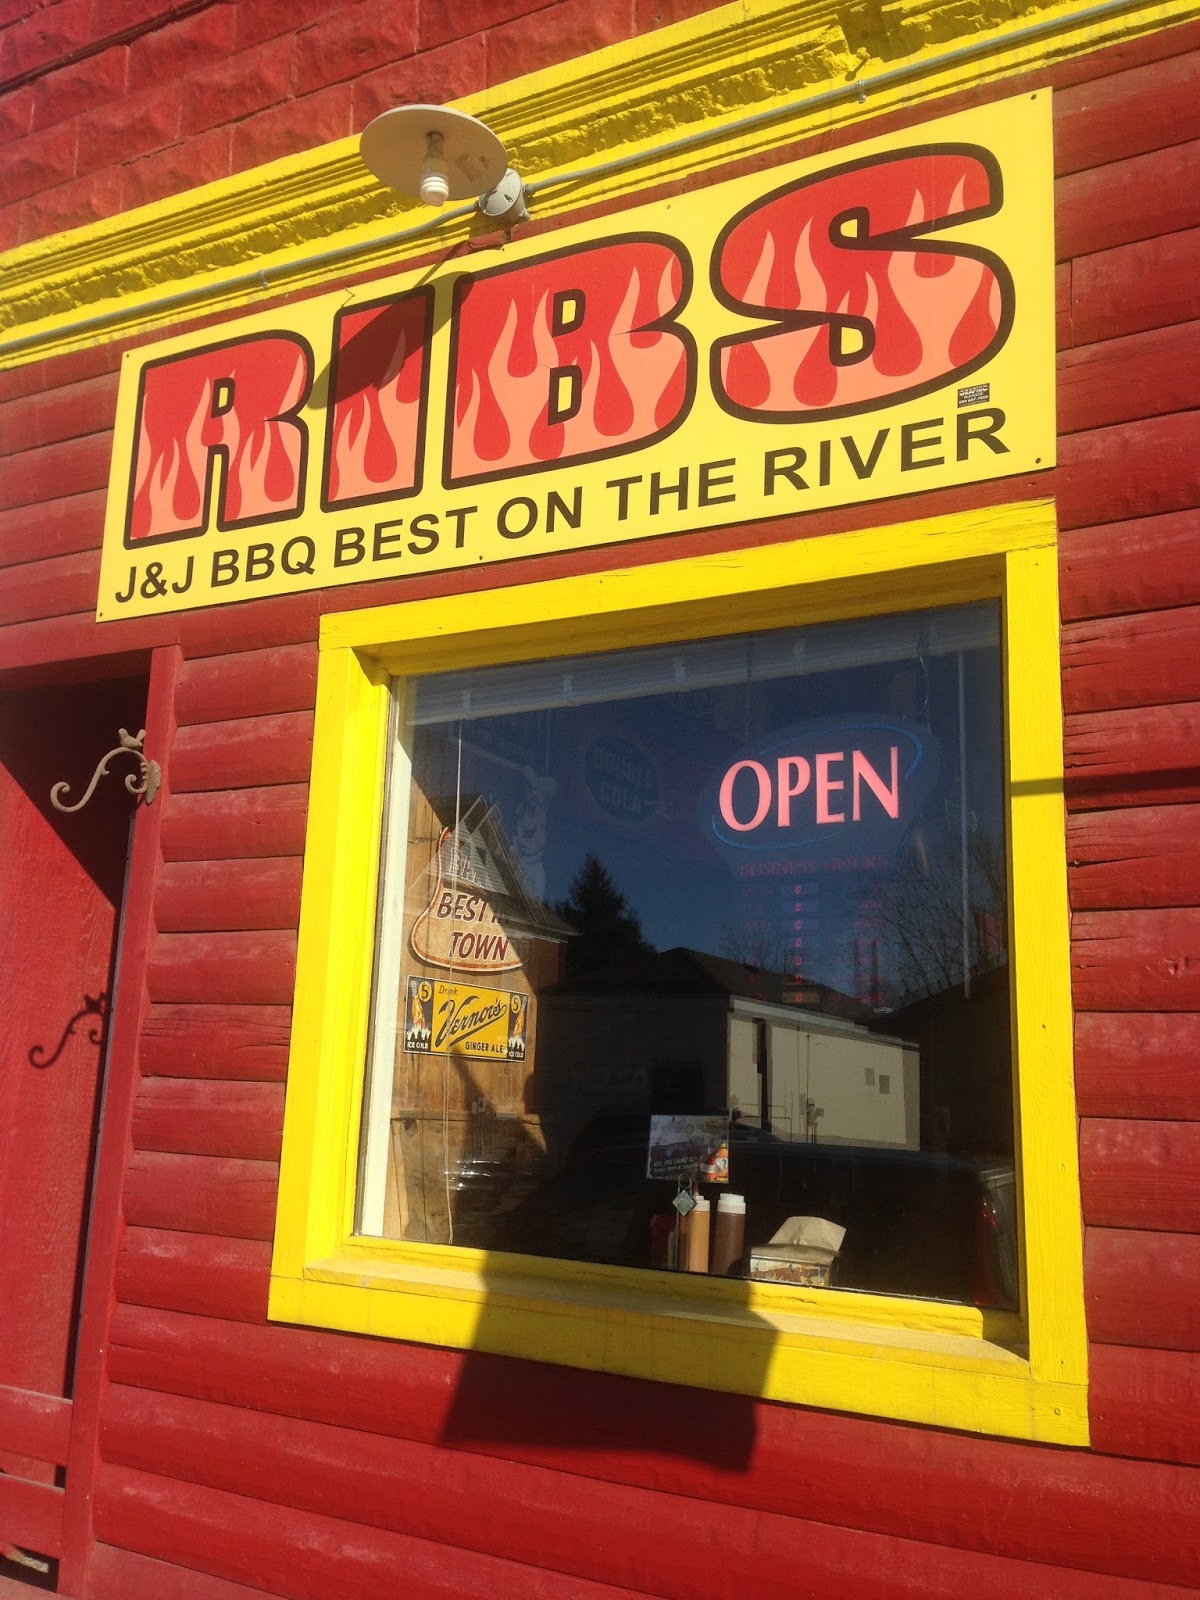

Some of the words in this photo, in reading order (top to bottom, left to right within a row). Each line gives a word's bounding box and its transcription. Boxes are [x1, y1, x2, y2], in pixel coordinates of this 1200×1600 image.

[124, 143, 1015, 550] RIBS
[116, 556, 193, 602] J&J
[211, 536, 315, 587] BBQ
[334, 506, 477, 567] BEST
[498, 487, 582, 539] ON
[607, 458, 735, 520] THE
[764, 408, 1009, 496] RIVER
[719, 746, 899, 832] OPEN
[436, 892, 489, 924] BEST
[449, 931, 511, 962] TOWN
[438, 984, 458, 997] Drink
[435, 995, 507, 1051] Vernor's
[465, 1041, 489, 1052] GINGER
[491, 1043, 504, 1053] ALE
